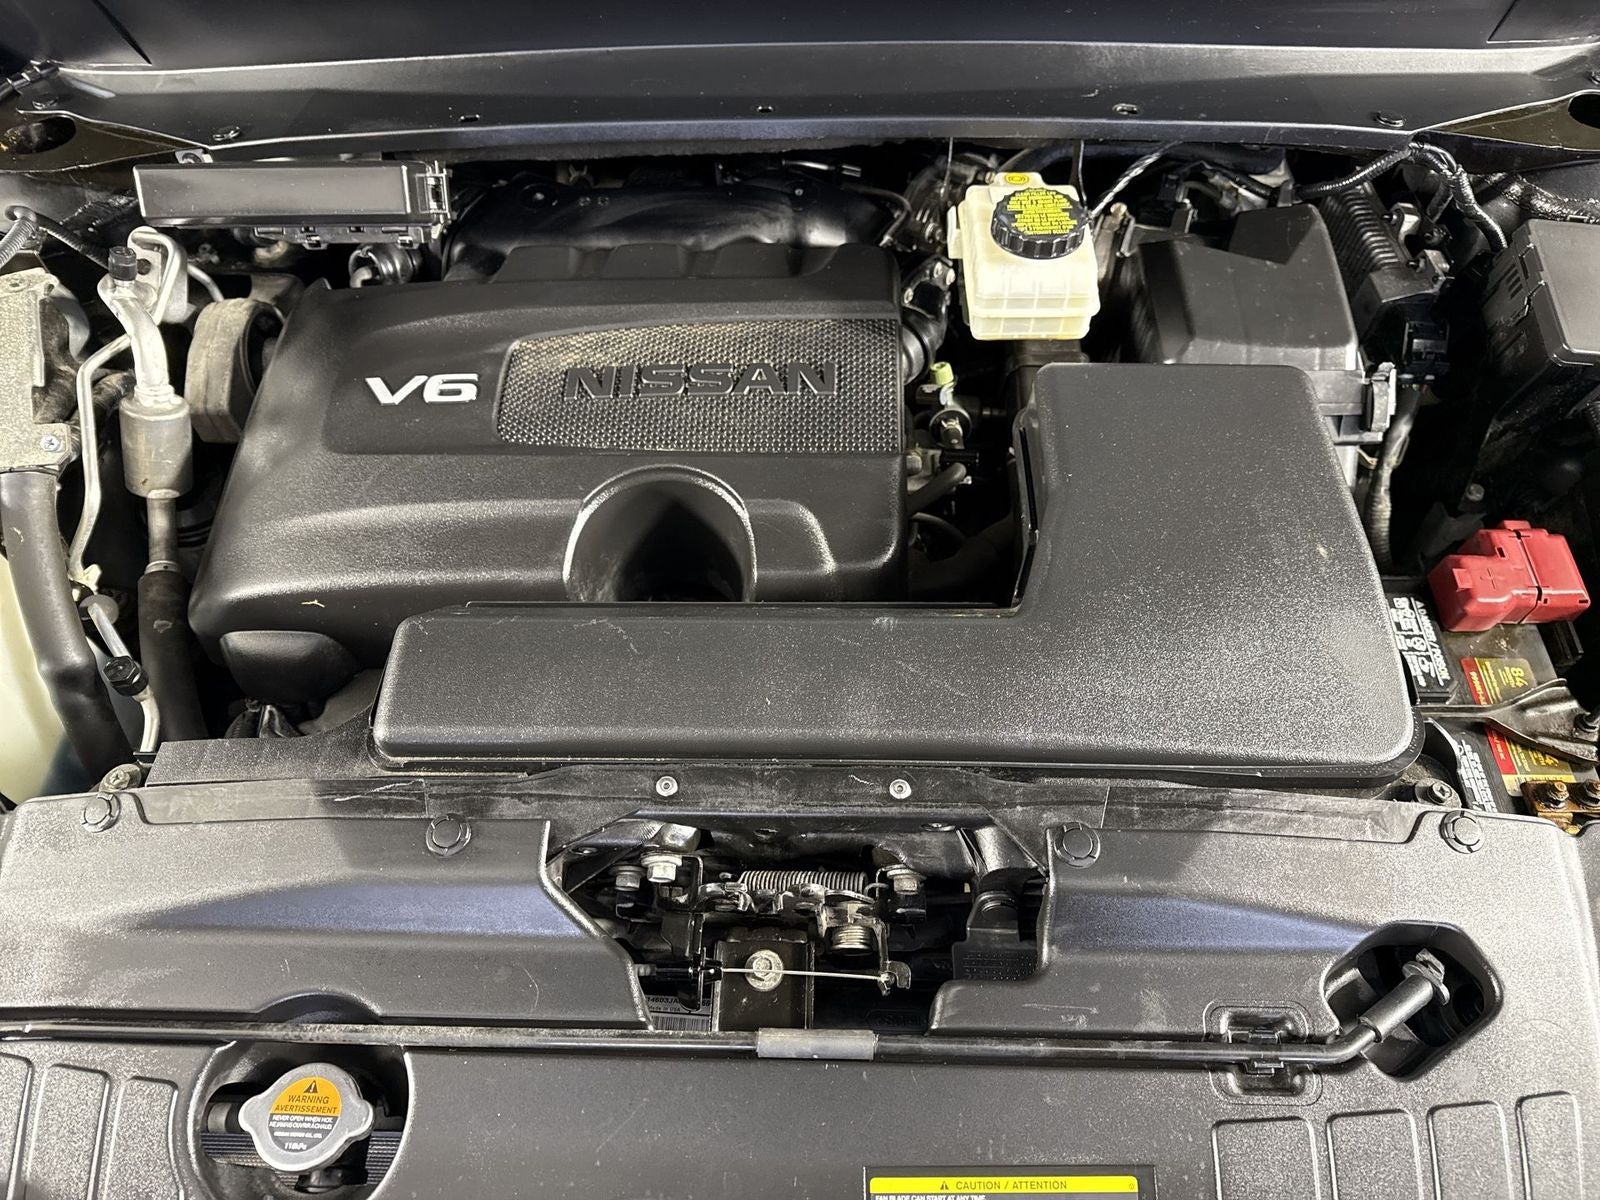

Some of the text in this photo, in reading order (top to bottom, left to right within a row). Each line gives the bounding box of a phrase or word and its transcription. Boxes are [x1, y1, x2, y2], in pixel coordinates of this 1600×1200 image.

[365, 373, 479, 406] V6
[564, 361, 837, 400] NISSAN
[1431, 648, 1452, 680] POISON
[1511, 667, 1529, 687] 84
[274, 1105, 338, 1114] AVERTISSEMENT
[288, 1095, 330, 1104] WARNING
[956, 1181, 1000, 1190] CAUTION
[1012, 1181, 1067, 1190] ATTENTION
